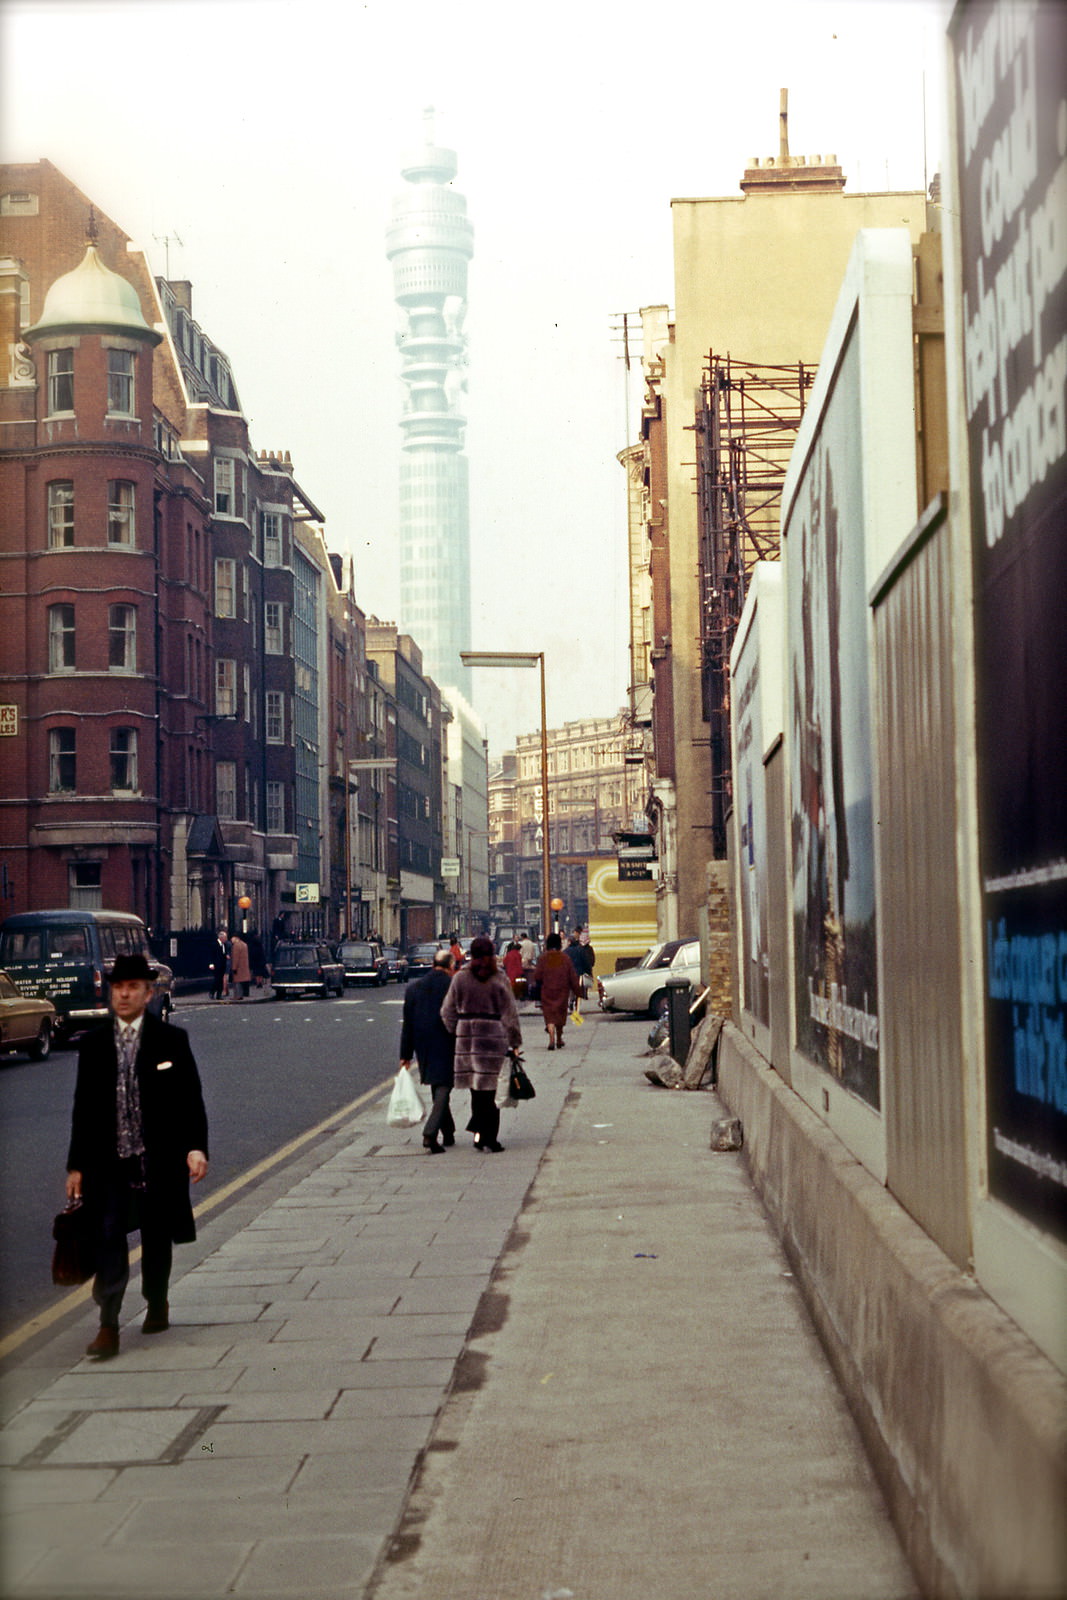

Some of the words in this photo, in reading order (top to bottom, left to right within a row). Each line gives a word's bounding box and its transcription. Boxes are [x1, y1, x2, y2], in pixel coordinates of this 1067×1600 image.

[980, 20, 1037, 257] could
[964, 257, 997, 425] help
[982, 428, 1004, 547] to
[1003, 335, 1067, 519] cancer
